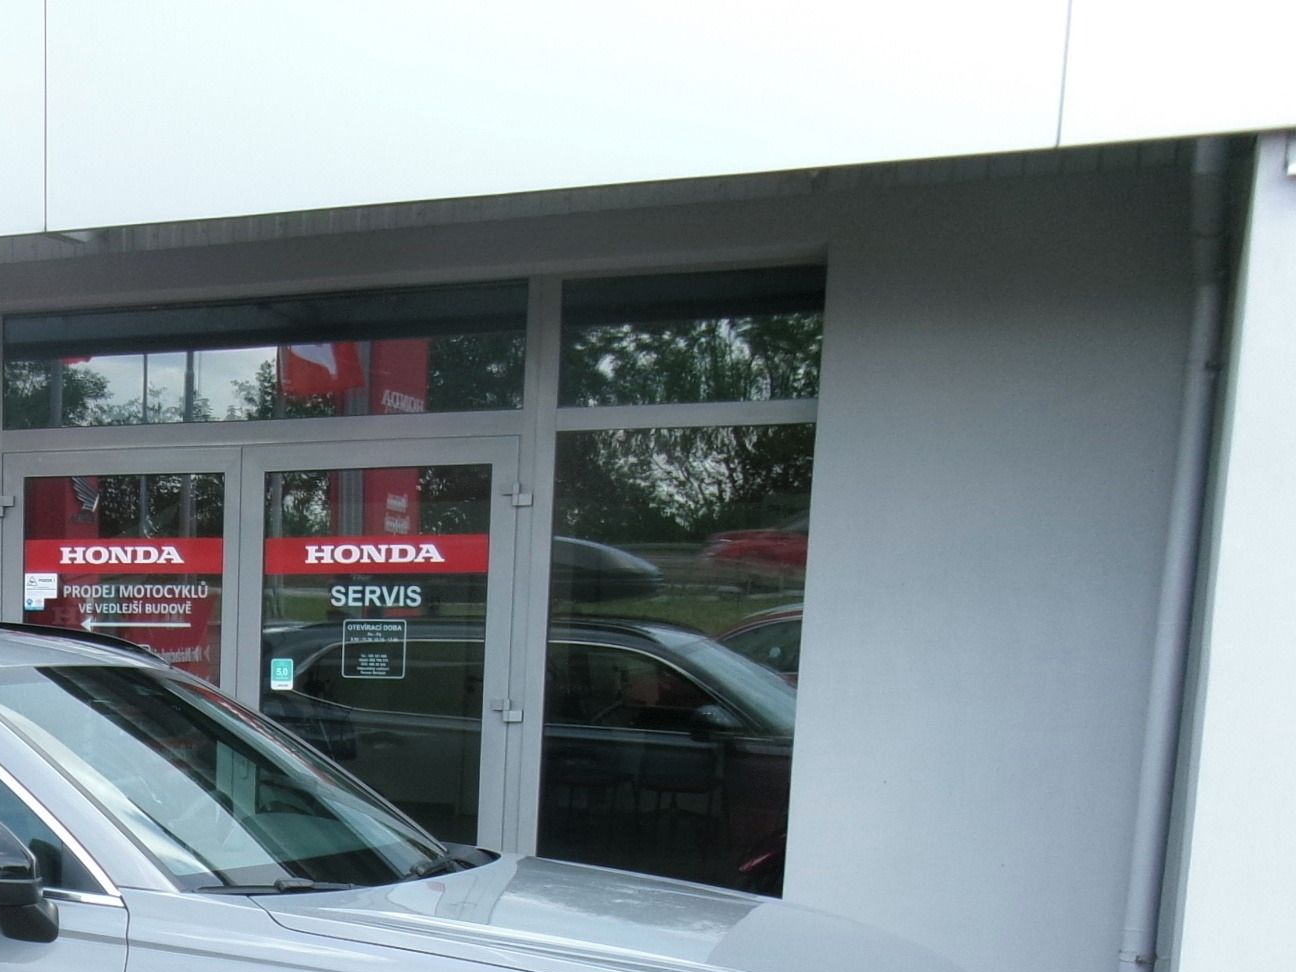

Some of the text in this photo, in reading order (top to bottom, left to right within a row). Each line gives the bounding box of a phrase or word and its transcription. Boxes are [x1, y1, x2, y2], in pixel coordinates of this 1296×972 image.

[60, 546, 184, 564] HONDA
[305, 544, 445, 564] HONDA
[63, 580, 208, 598] PRODEJ MOTOCYKLŮ
[330, 585, 422, 607] SERVIS
[78, 600, 192, 614] VE VEDLEJŠÍ BUDOVĚ
